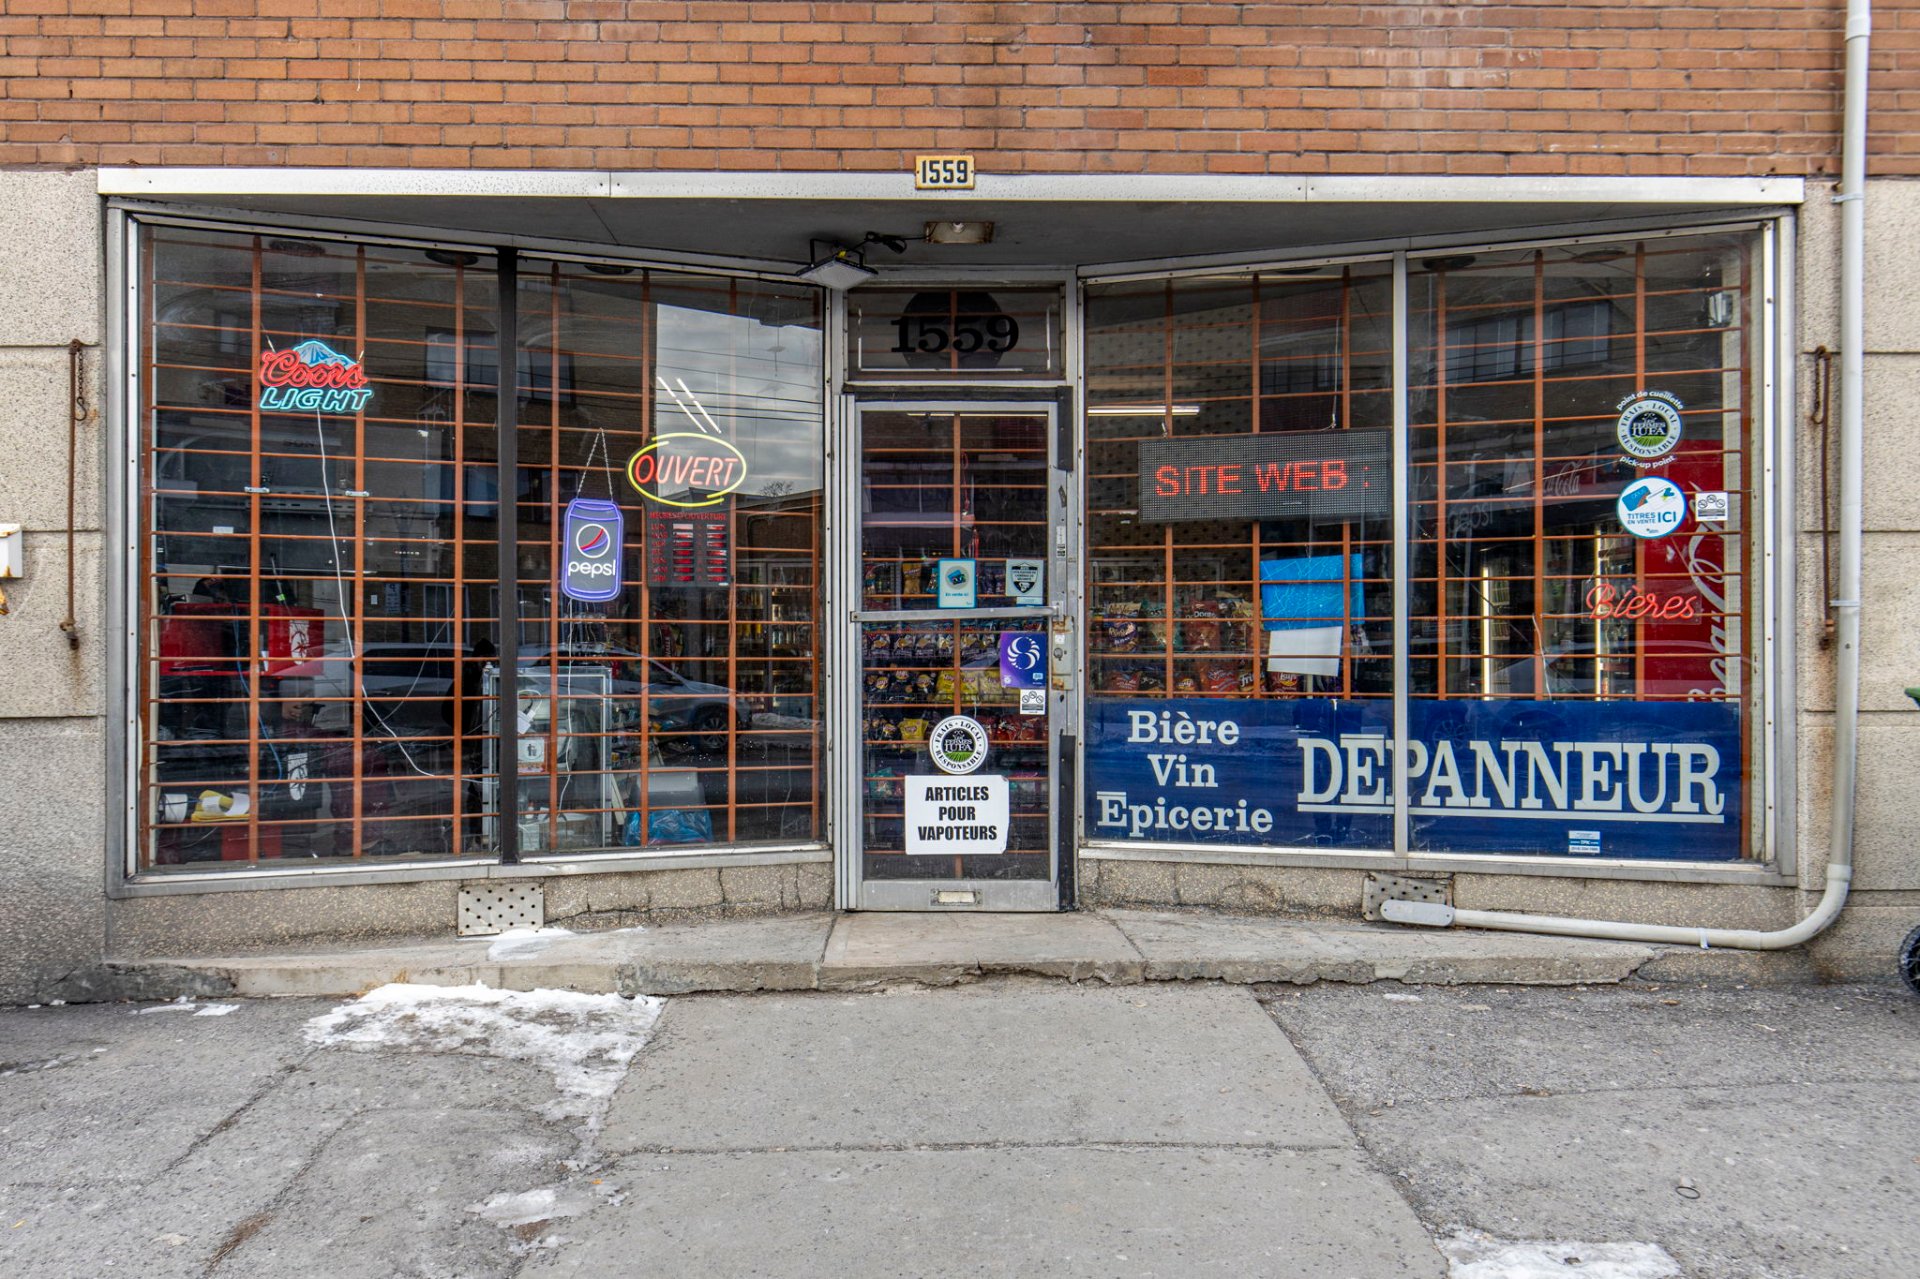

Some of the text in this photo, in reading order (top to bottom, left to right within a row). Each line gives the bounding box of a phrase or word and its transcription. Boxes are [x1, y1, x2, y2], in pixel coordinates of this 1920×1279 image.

[922, 159, 969, 184] 1559
[890, 314, 1019, 353] 1559
[260, 349, 369, 389] Coors
[259, 386, 373, 411] LIGHT
[1616, 393, 1636, 411] point
[1621, 404, 1643, 427] FRAIS
[1620, 433, 1677, 455] RESPONSABLE
[634, 454, 740, 487] OUVERT
[1619, 455, 1677, 469] pick-up point
[1154, 465, 1243, 497] SITE
[1255, 459, 1349, 492] WEB
[1657, 511, 1677, 523] ICI
[567, 558, 616, 578] pepsi
[1585, 583, 1698, 620] Bières
[935, 721, 982, 743] FRAIS LOCAL
[1126, 710, 1240, 746] Bière
[935, 750, 982, 770] RESPONSABLE
[1147, 754, 1218, 788] Vin
[924, 786, 989, 801] ARTICLES
[938, 806, 976, 821] POUR
[917, 826, 998, 841] VAPOTEURS
